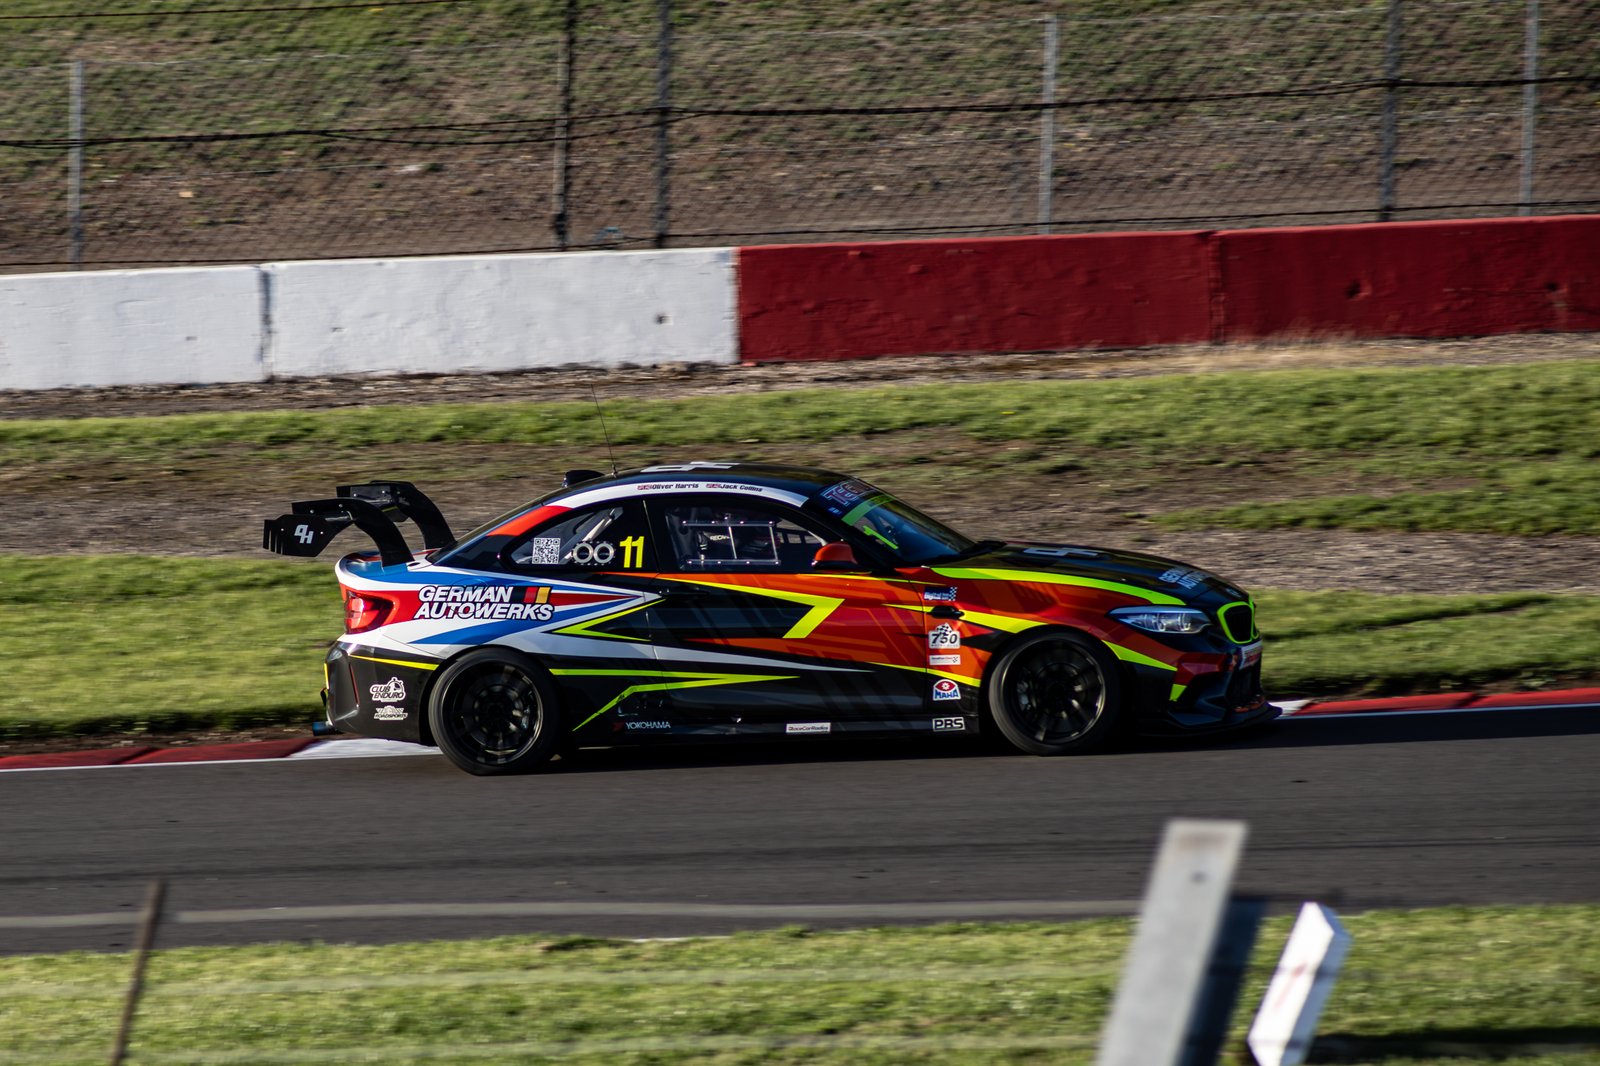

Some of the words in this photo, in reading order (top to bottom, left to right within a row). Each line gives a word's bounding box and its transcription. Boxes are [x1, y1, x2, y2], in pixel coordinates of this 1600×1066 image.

[675, 482, 699, 490] Harris
[720, 483, 738, 491] Jack
[619, 535, 645, 568] 11
[418, 585, 513, 602] GERMAN
[413, 602, 554, 621] AUTOWERKS
[931, 633, 958, 644] 750
[371, 685, 391, 693] CLUB
[934, 688, 960, 699] MAHA
[625, 721, 671, 730] YOKOHAMA
